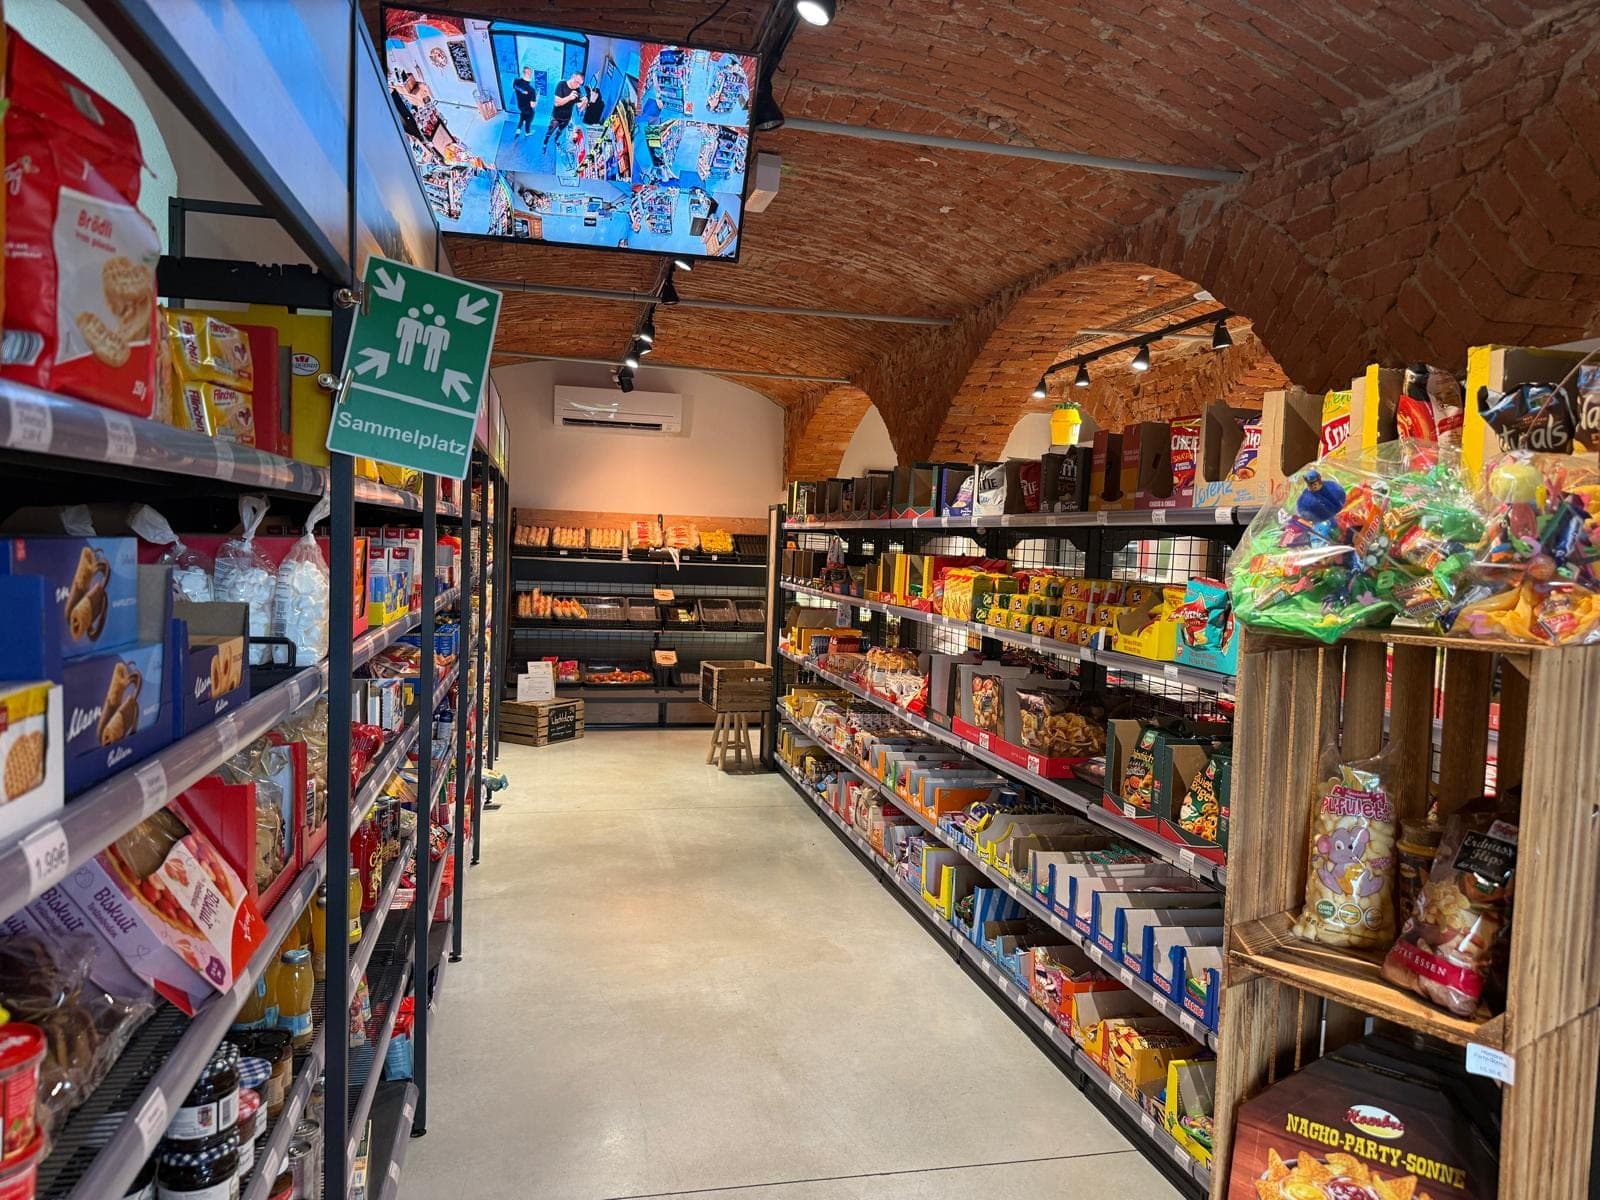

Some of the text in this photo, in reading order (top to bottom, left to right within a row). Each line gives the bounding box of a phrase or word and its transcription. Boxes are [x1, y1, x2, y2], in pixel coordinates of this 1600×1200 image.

[189, 389, 204, 433] Filinchen
[337, 411, 466, 456] Sammelplatz
[41, 887, 85, 932] Biskuit
[93, 886, 138, 934] Biskuit
[199, 886, 221, 930] Biskuit
[1414, 955, 1448, 977] ESSEN
[1285, 1112, 1467, 1190] NACHO-PARTY-SONNE
